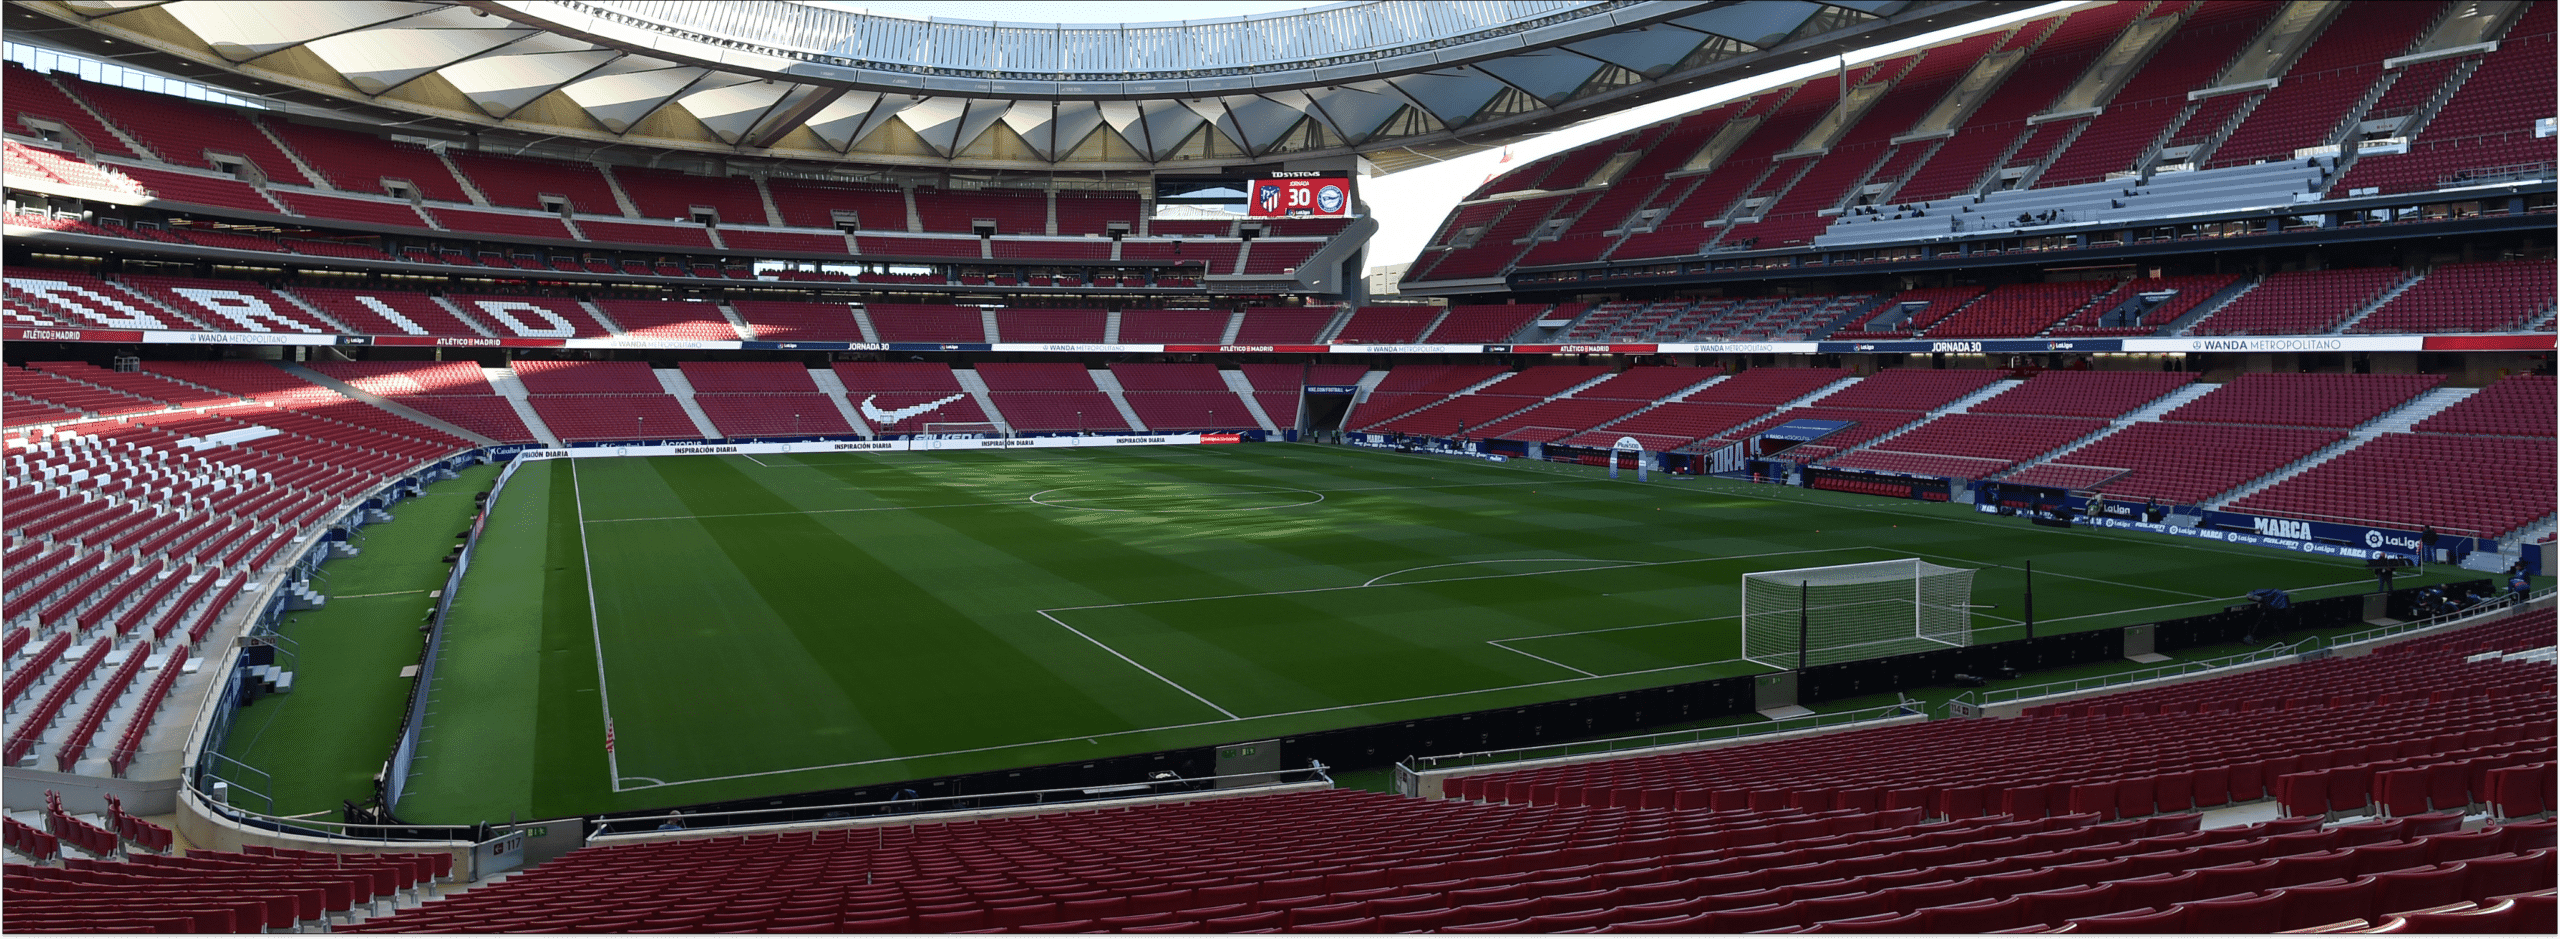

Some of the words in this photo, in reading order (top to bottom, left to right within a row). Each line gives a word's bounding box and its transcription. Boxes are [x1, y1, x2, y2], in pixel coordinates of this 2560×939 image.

[1288, 188, 1311, 206] 30
[23, 329, 51, 340] ATLÉTICO
[55, 330, 81, 340] MADRID
[198, 334, 228, 342] WANDA
[229, 334, 287, 344] METROPOLITANO
[437, 337, 468, 345] ATLÉTICO
[474, 338, 501, 346] MADRID
[2056, 342, 2073, 350] LaLiga
[2204, 340, 2248, 350] WANDA
[2250, 340, 2341, 350] METROPOLITANO
[1932, 342, 1970, 352] JORNADA
[1970, 342, 1982, 352] 30
[675, 446, 714, 454] INSPIRACIÓN
[834, 442, 871, 450] INSPIRACIÓN
[2103, 504, 2131, 515] LaLiga
[2178, 527, 2197, 535] LaLiga
[2254, 517, 2312, 540] MARCA
[2200, 529, 2223, 539] MARCA
[2237, 534, 2257, 544] LaLiga
[2314, 545, 2336, 555] LaLiga
[2339, 547, 2367, 558] MARCA
[1950, 703, 1961, 713] 114
[507, 837, 521, 851] 117
